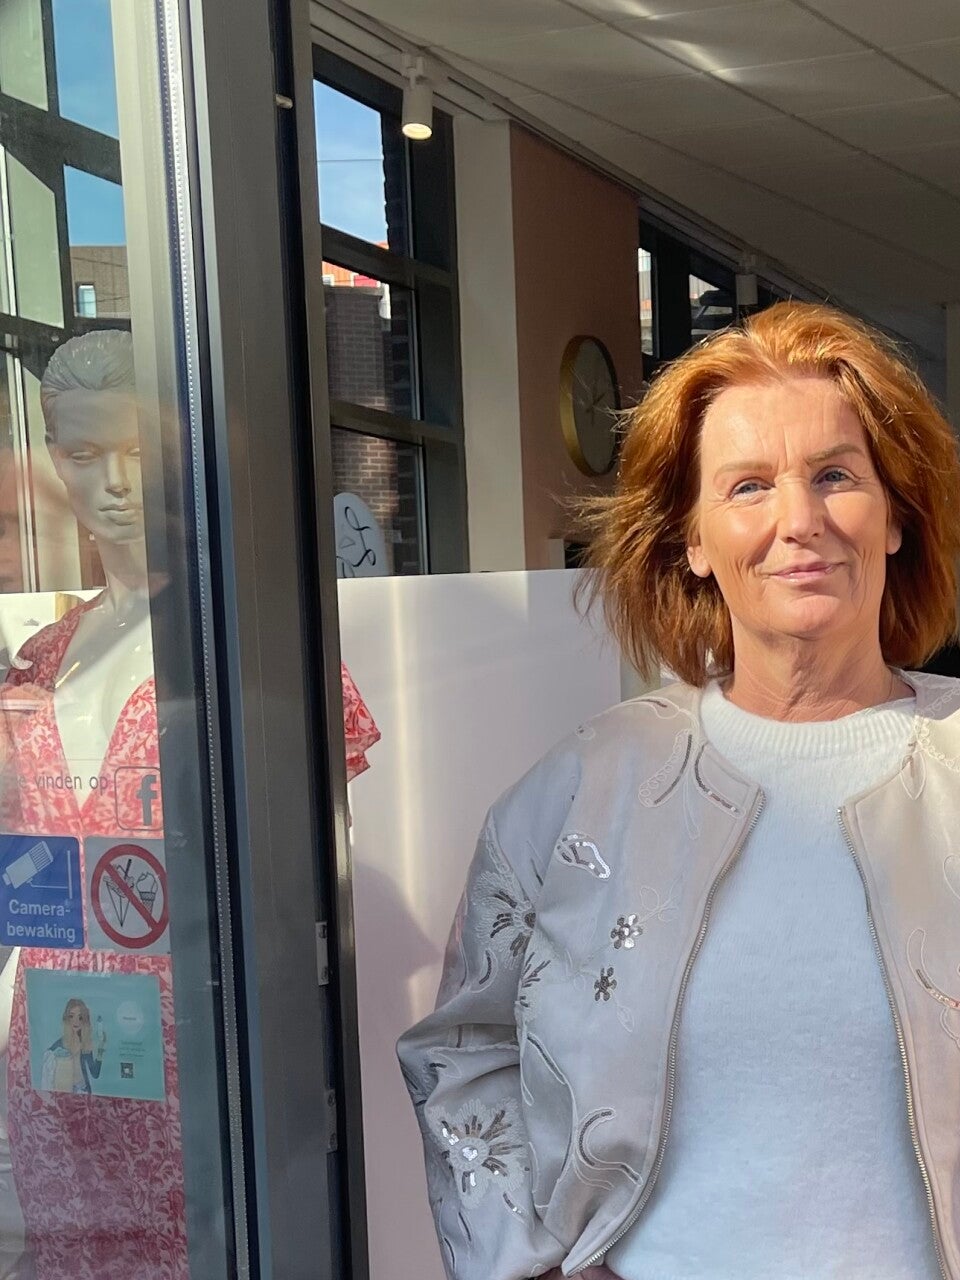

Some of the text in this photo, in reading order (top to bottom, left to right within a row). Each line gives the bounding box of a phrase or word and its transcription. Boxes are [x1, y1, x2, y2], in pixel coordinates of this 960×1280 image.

[35, 770, 83, 791] vinden
[89, 776, 110, 796] op
[8, 898, 71, 917] Camera-
[6, 920, 76, 944] bewaking
